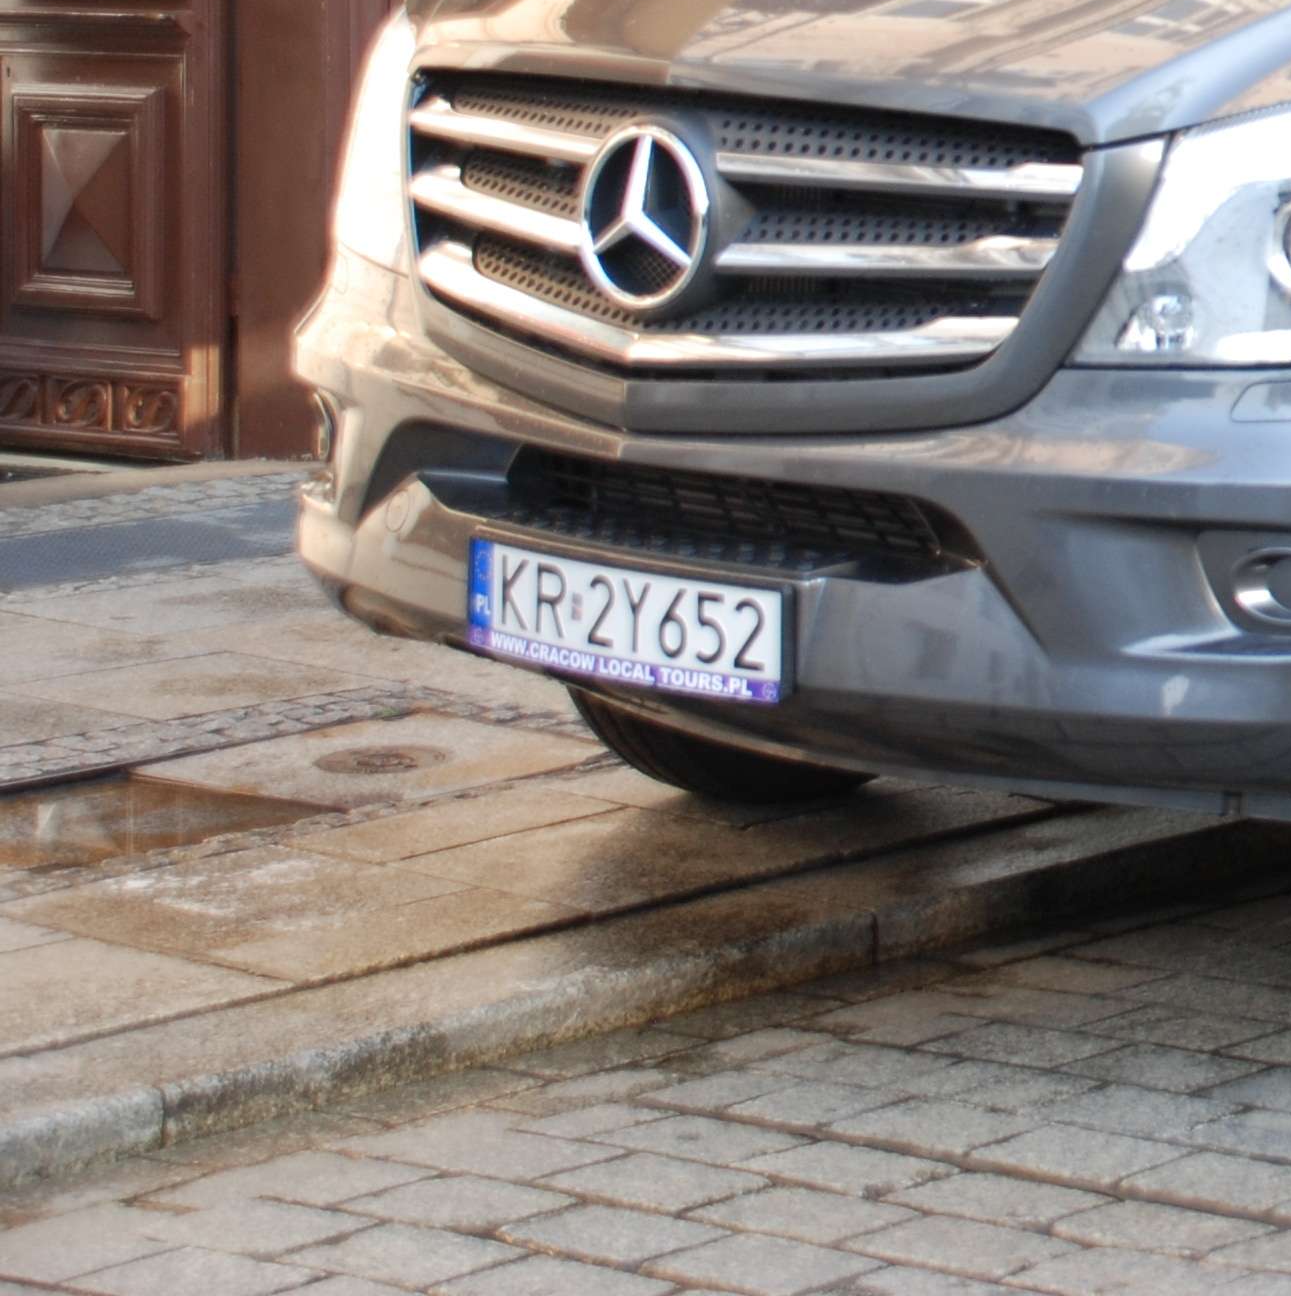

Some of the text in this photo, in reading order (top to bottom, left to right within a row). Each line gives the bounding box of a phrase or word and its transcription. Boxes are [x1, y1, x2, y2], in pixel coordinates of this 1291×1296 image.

[475, 593, 491, 616] PL
[502, 554, 766, 672] KR 2Y652
[490, 632, 753, 697] WWW.CRACOW LOCAL TOURS.PL
